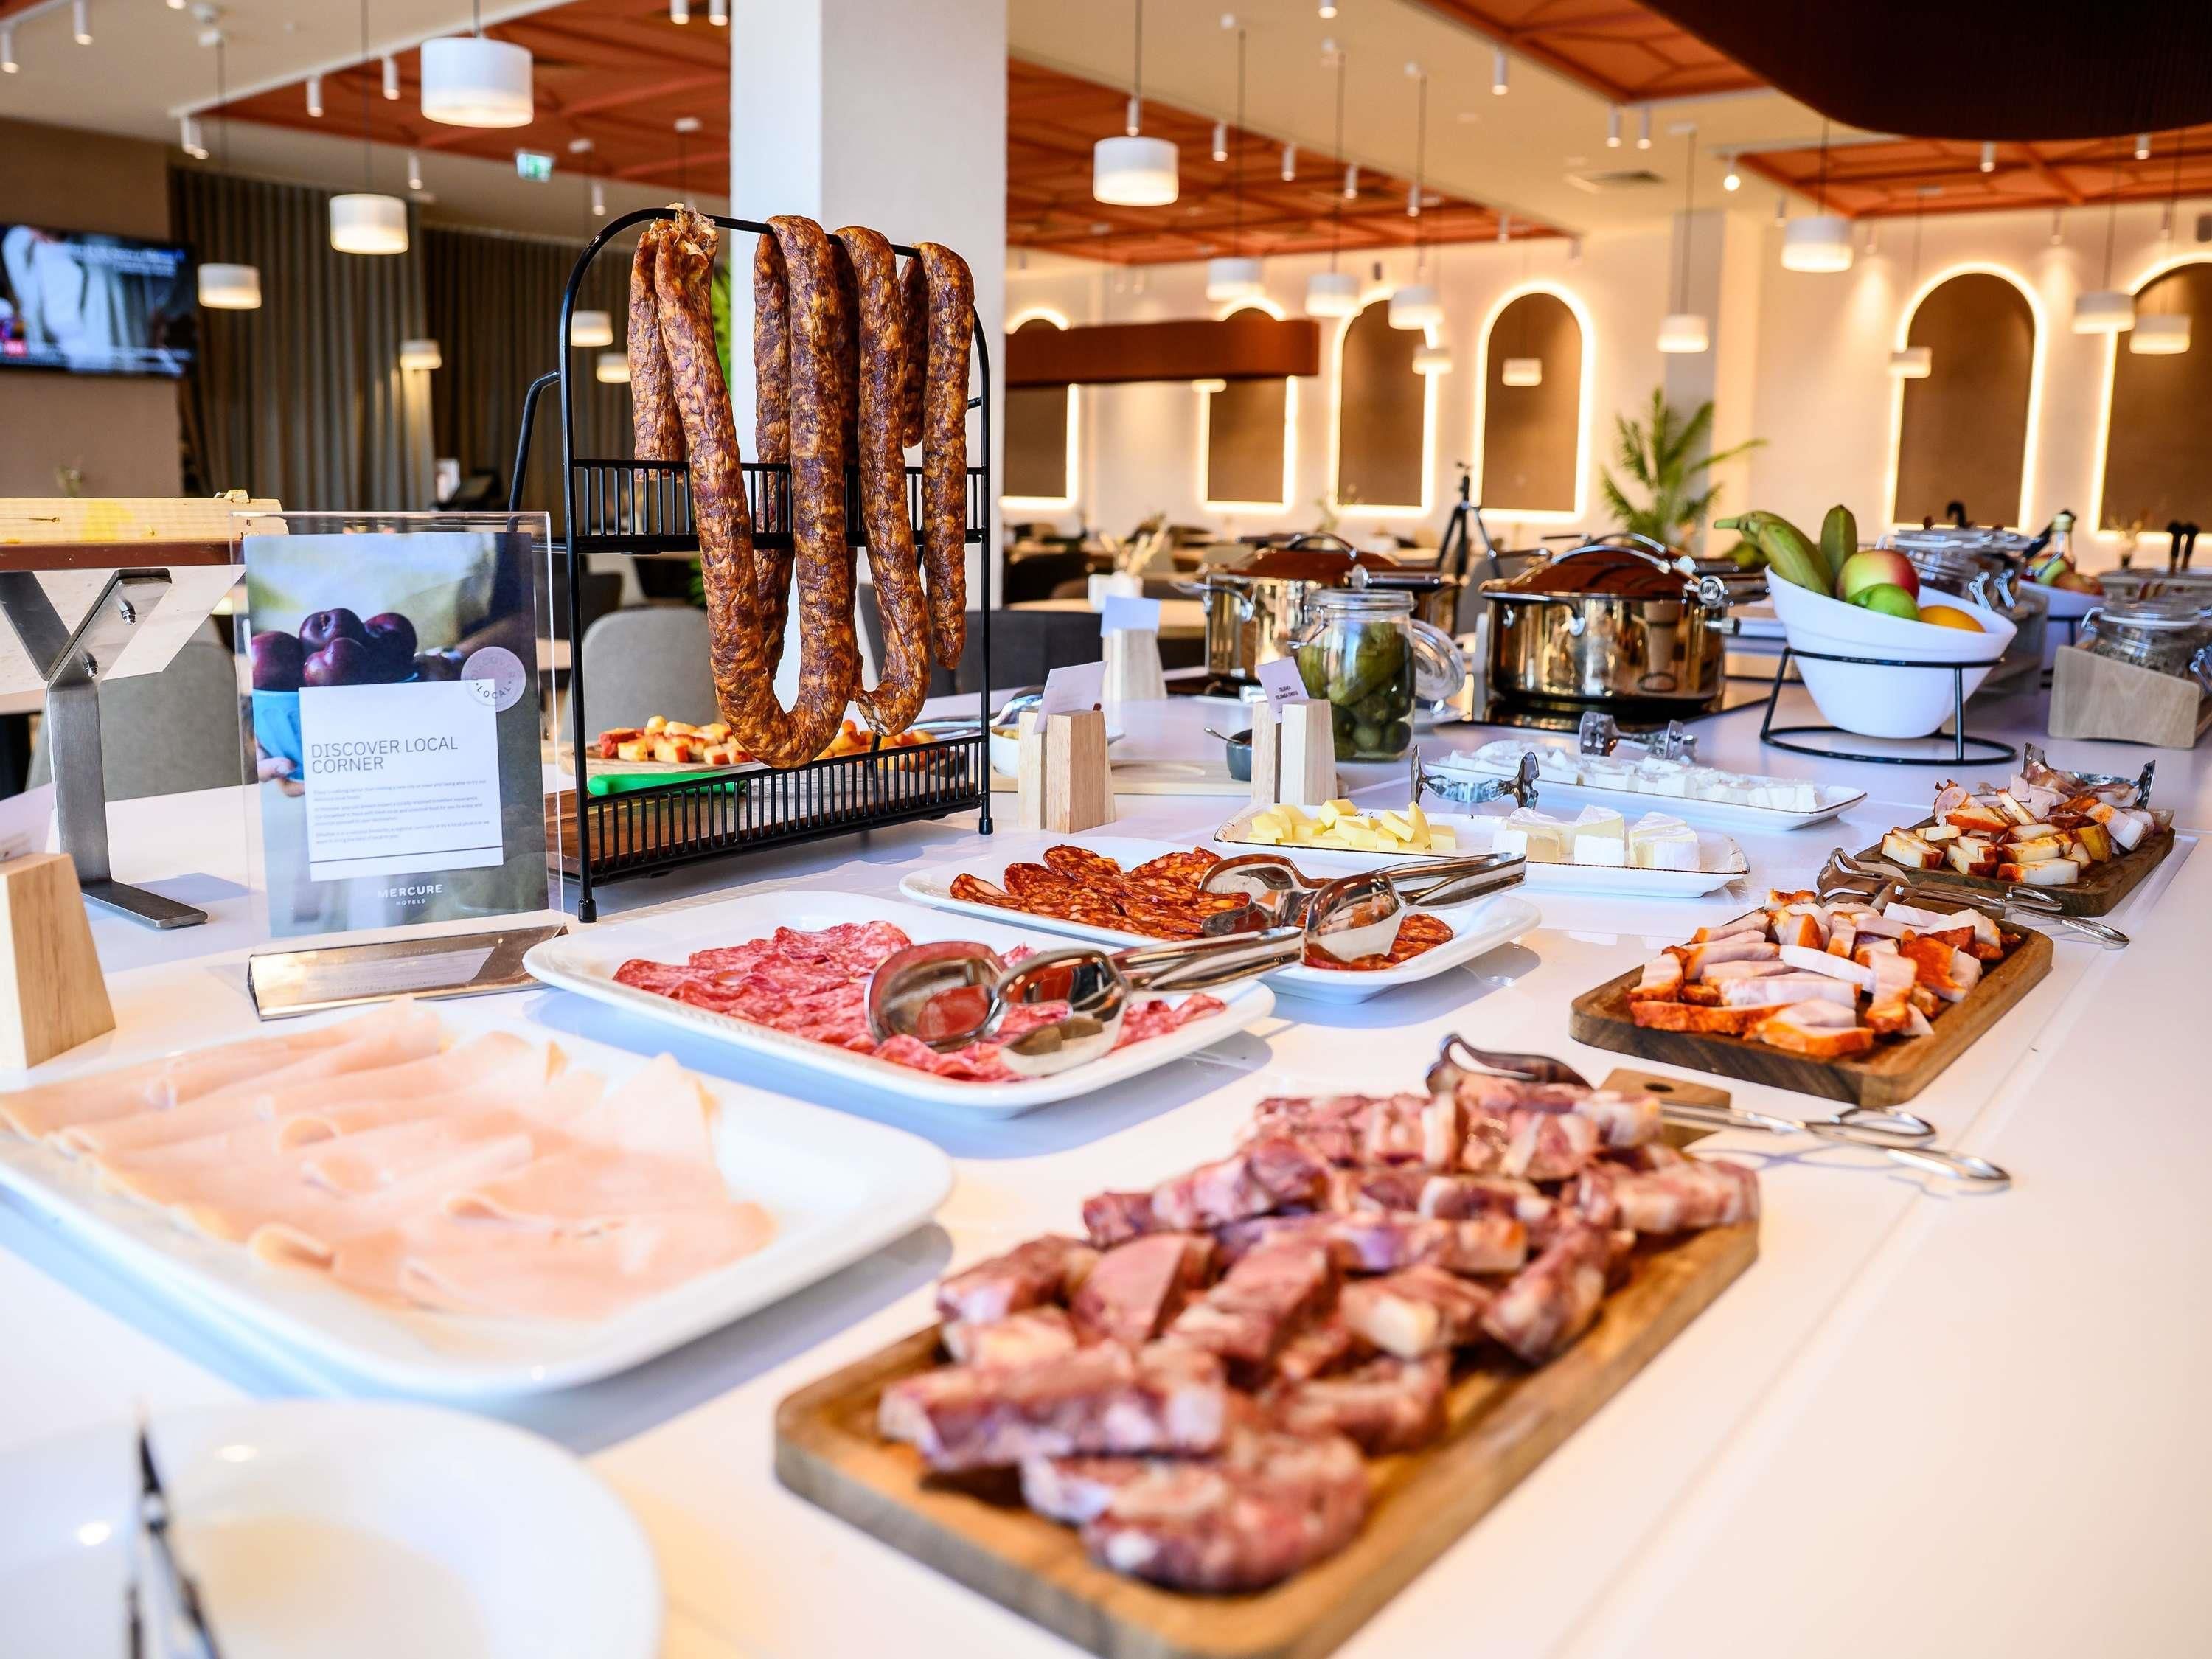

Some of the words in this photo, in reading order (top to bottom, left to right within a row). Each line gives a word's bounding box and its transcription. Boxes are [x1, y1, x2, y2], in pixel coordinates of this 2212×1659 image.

[477, 686, 511, 699] LOCAL
[311, 740, 400, 758] DISCOVER
[406, 737, 458, 753] LOCAL
[312, 757, 383, 773] CORNER
[377, 884, 443, 898] MERCURE
[396, 898, 426, 906] HOTELS
